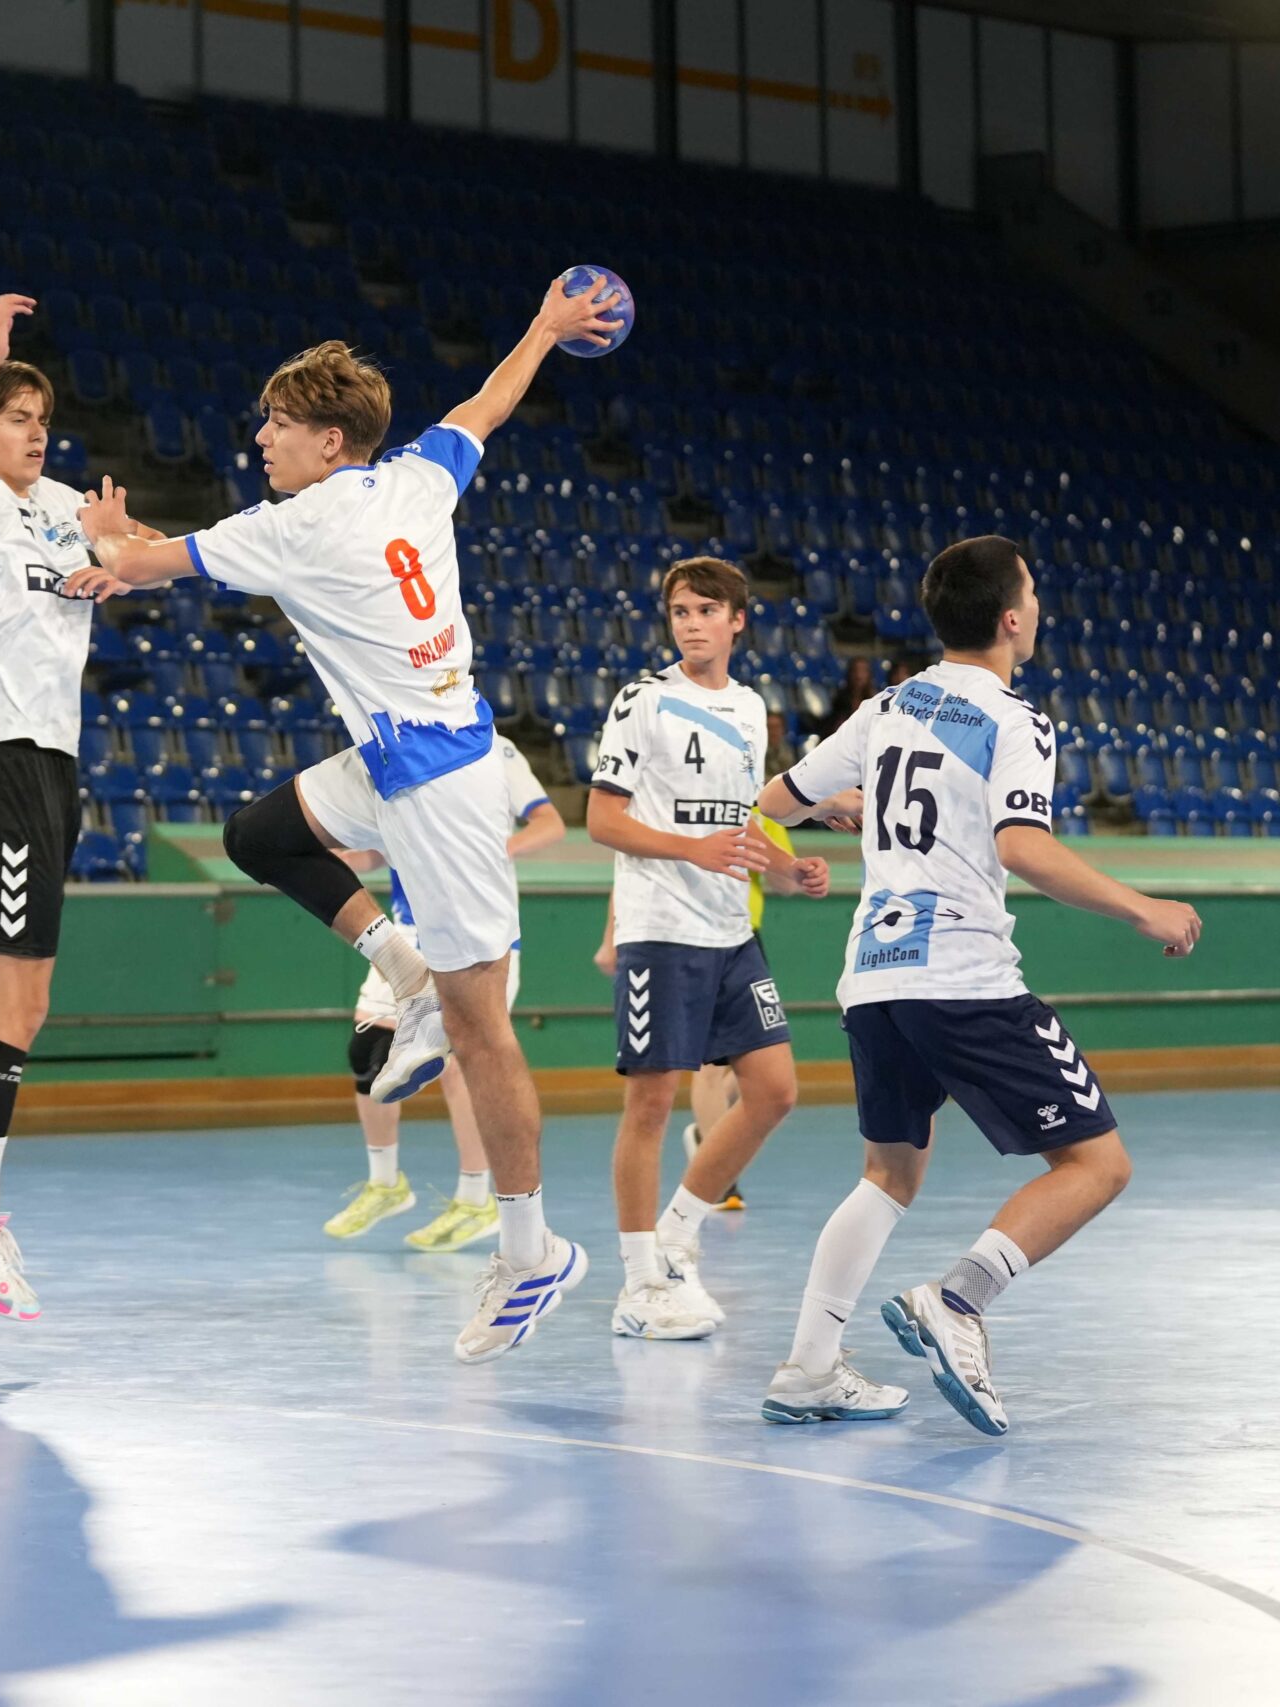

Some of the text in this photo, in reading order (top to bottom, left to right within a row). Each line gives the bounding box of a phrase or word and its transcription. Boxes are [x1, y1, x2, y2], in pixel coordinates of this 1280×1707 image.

[494, 0, 561, 84] D
[385, 538, 436, 620] 8
[408, 624, 455, 669] ORLANDO
[685, 732, 705, 774] 4
[876, 746, 944, 856] 15
[1006, 789, 1052, 816] OB
[861, 947, 920, 968] LightCom
